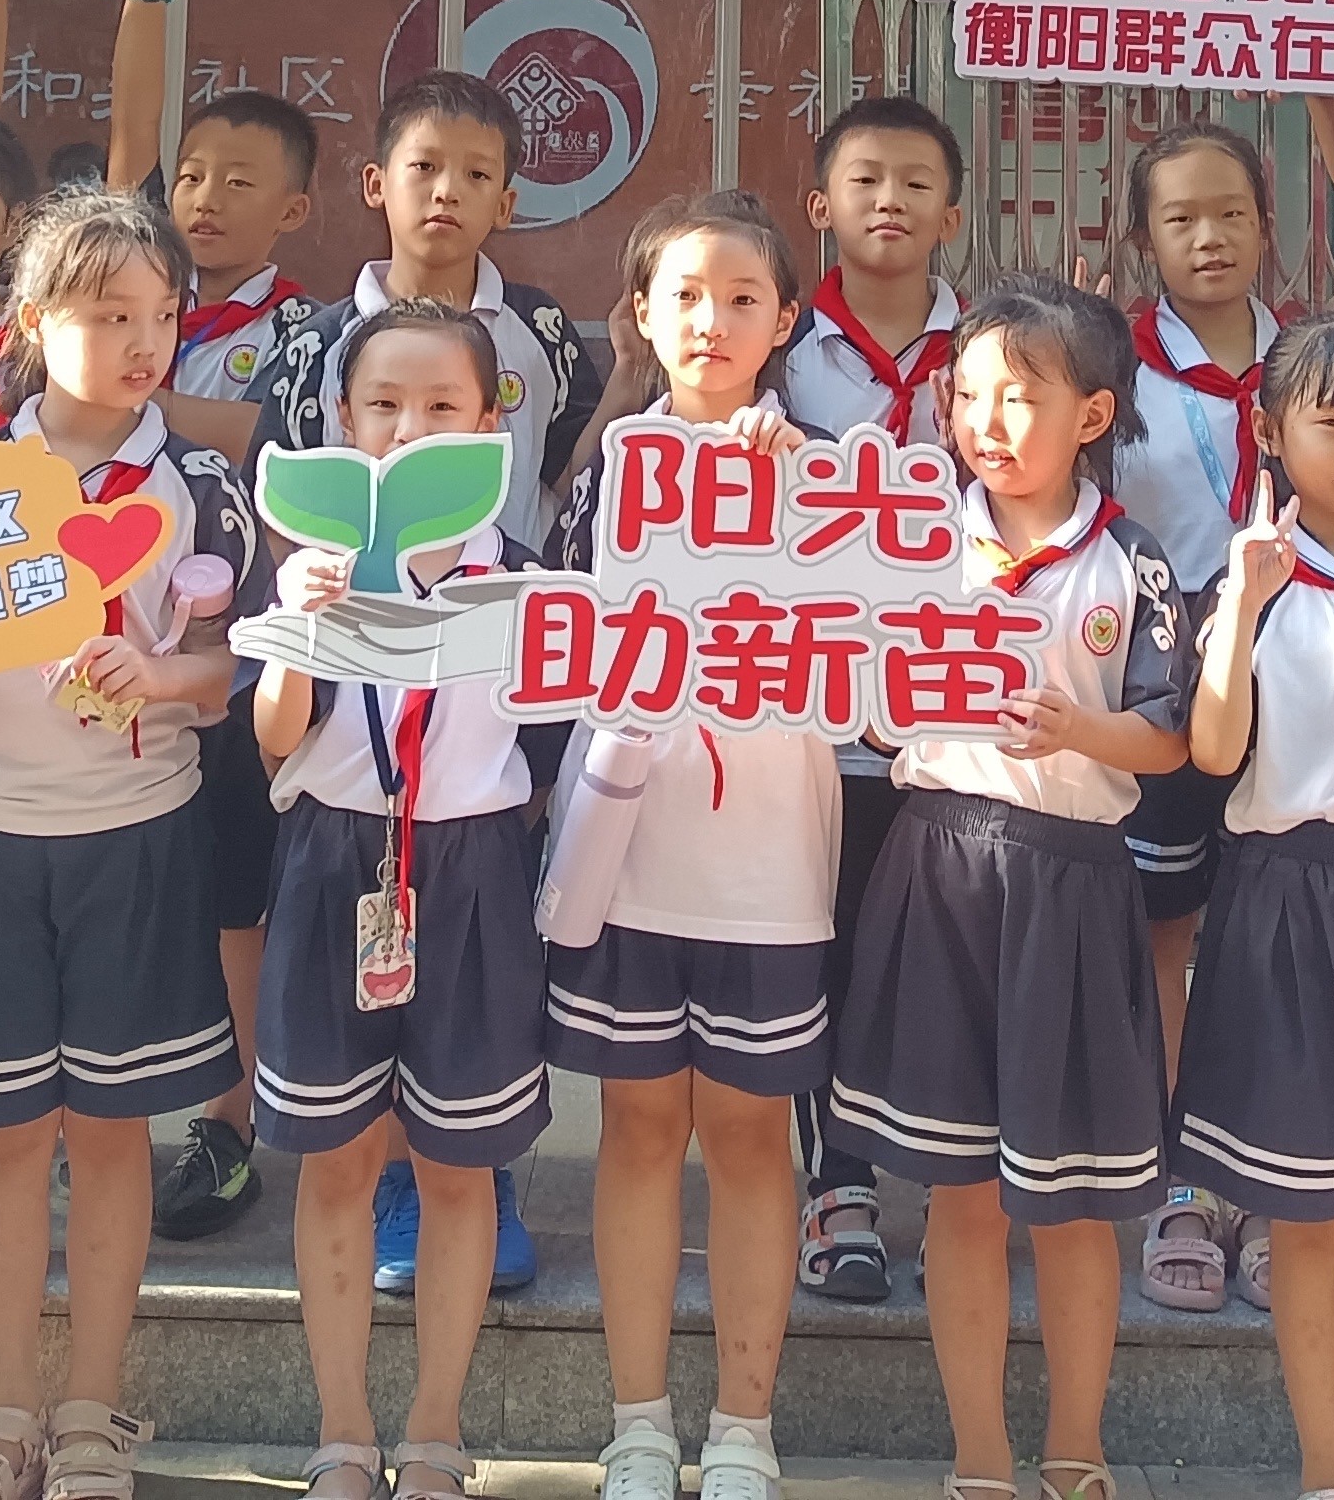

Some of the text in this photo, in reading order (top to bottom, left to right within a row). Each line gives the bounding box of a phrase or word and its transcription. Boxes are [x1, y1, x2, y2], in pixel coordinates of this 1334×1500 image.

[1, 47, 353, 123] 和社区
[616, 434, 955, 562] 阳光
[508, 589, 1042, 726] 助新苗
